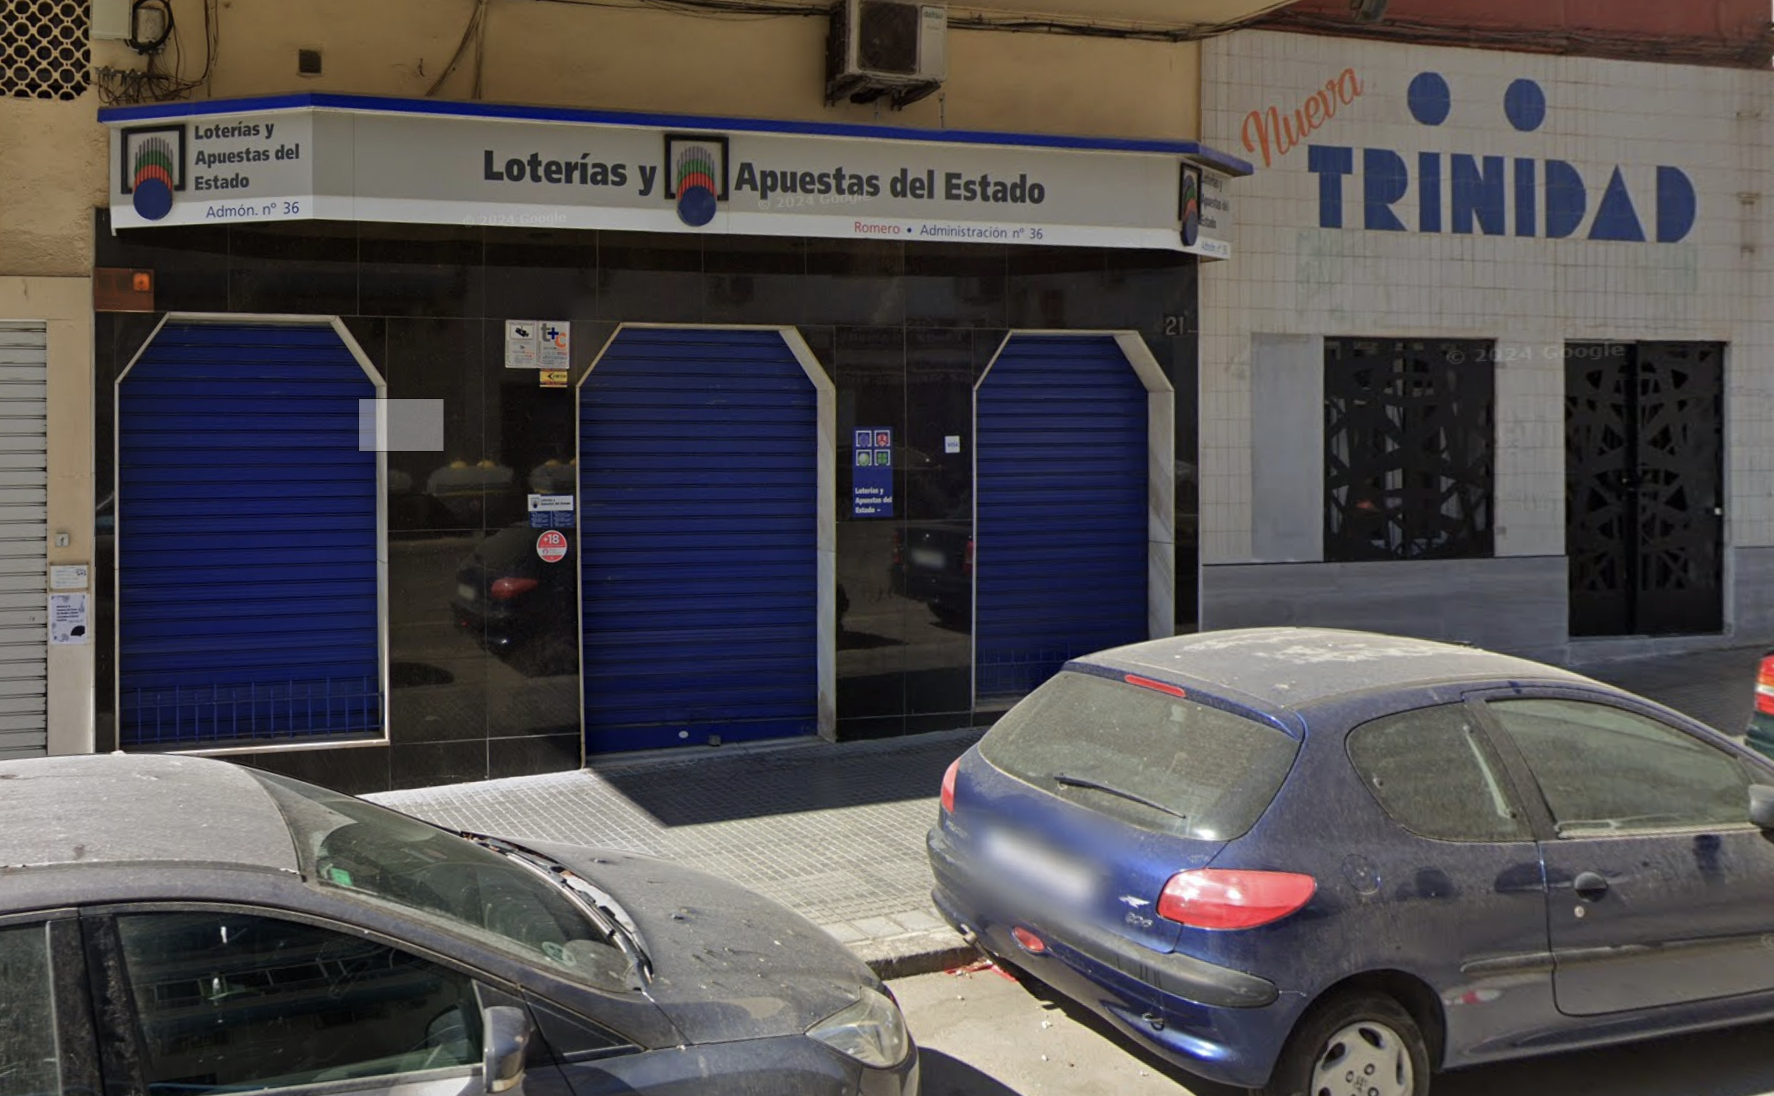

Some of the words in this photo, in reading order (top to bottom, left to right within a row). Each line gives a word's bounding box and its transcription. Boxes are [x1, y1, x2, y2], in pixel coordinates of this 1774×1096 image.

[1241, 67, 1364, 168] Nueva
[195, 121, 260, 140] Loterías
[265, 123, 275, 140] y
[195, 147, 270, 169] Apuestas
[275, 143, 300, 161] del
[195, 172, 250, 191] Estado
[484, 150, 628, 186] Loterías
[638, 165, 657, 197] y
[734, 162, 881, 200] Apuestas
[890, 168, 934, 199] del
[945, 172, 1046, 205] Estado
[1308, 145, 1697, 243] TRINIDAD
[206, 204, 259, 219] Admón.
[283, 201, 300, 215] 36
[854, 221, 900, 235] Romero
[920, 224, 1008, 239] Administración
[1029, 228, 1043, 240] 36
[1165, 316, 1185, 336] 21
[855, 497, 882, 505] Apuestas
[543, 534, 560, 545] +18
